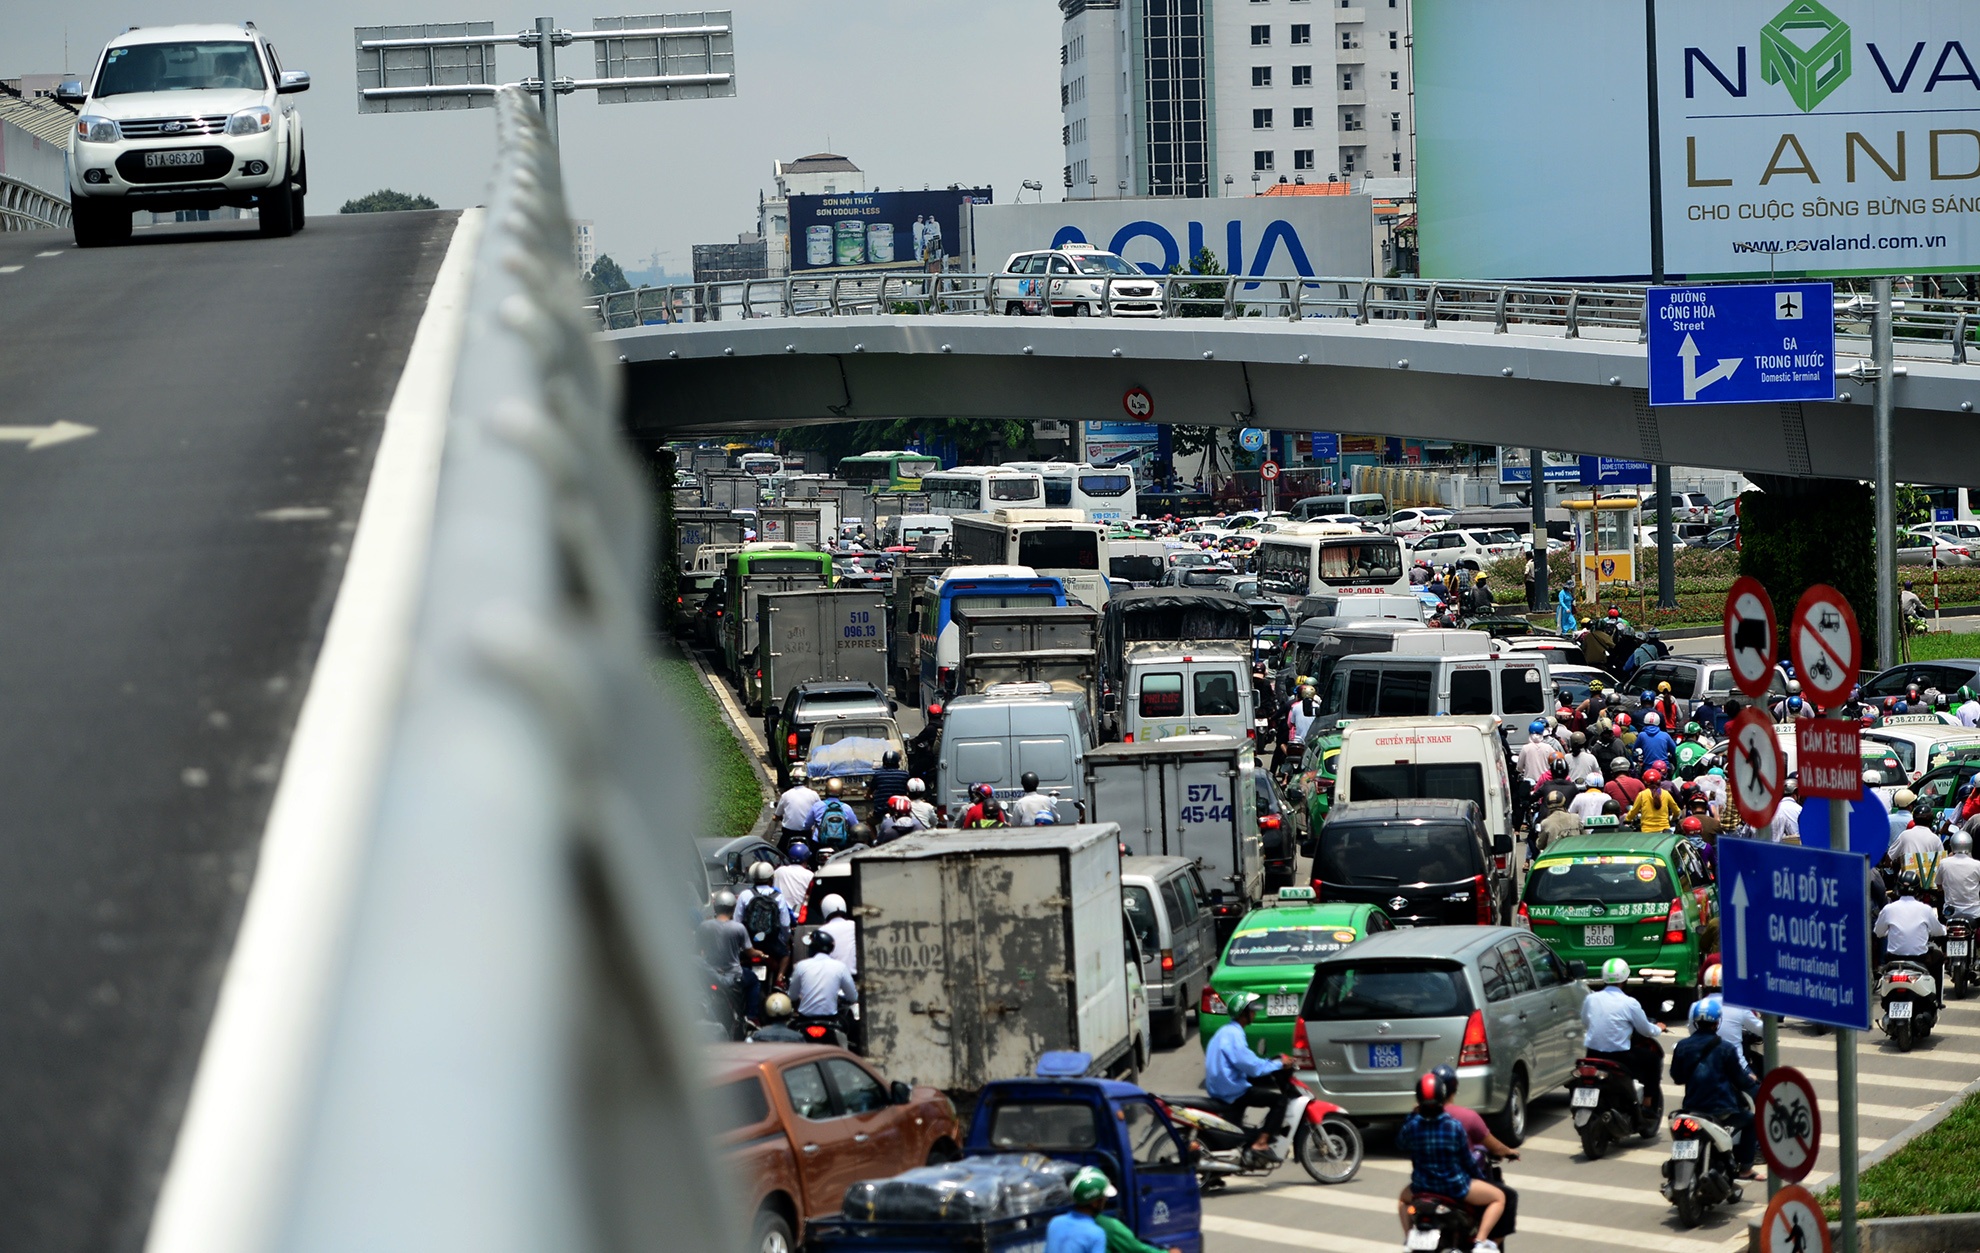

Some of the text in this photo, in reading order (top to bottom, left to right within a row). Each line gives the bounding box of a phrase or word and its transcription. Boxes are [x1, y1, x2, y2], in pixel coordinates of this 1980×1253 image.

[1686, 129, 1980, 187] LAND
[822, 195, 873, 207] SƠN NỘI THẤT
[833, 207, 881, 216] ODOUR-LESS
[1687, 204, 1730, 220] CHO
[1738, 199, 1795, 221] CUỘC
[1867, 195, 1926, 216] BỪNG
[1732, 233, 1947, 254] www.novaland.com.vn
[1670, 290, 1706, 303] ĐƯỜNG
[1660, 303, 1716, 321] CỘNG HÒA
[1673, 320, 1705, 331] Street
[1783, 337, 1798, 351] GA
[1754, 350, 1825, 369] TRONG NƯỚC
[1761, 371, 1821, 383] Domestic Terminal
[850, 611, 869, 624] 51D
[844, 625, 876, 638] 096.13
[837, 640, 884, 649] EXPRESS
[1427, 735, 1452, 743] NHANH
[1802, 723, 1857, 755] CẤM XE HAI
[1802, 761, 1815, 788] VÀ
[1188, 784, 1224, 802] 57L
[1590, 816, 1611, 825] TAXI
[1282, 888, 1311, 898] TAXI
[1773, 866, 1839, 907] BÃI ĐỖ XE
[1531, 907, 1550, 915] TAXI
[1591, 926, 1607, 935] 51F
[1769, 910, 1849, 953] GA QUỐC TẾ
[1778, 950, 1840, 978] International
[1765, 971, 1854, 1008] Terminal Parking Lot
